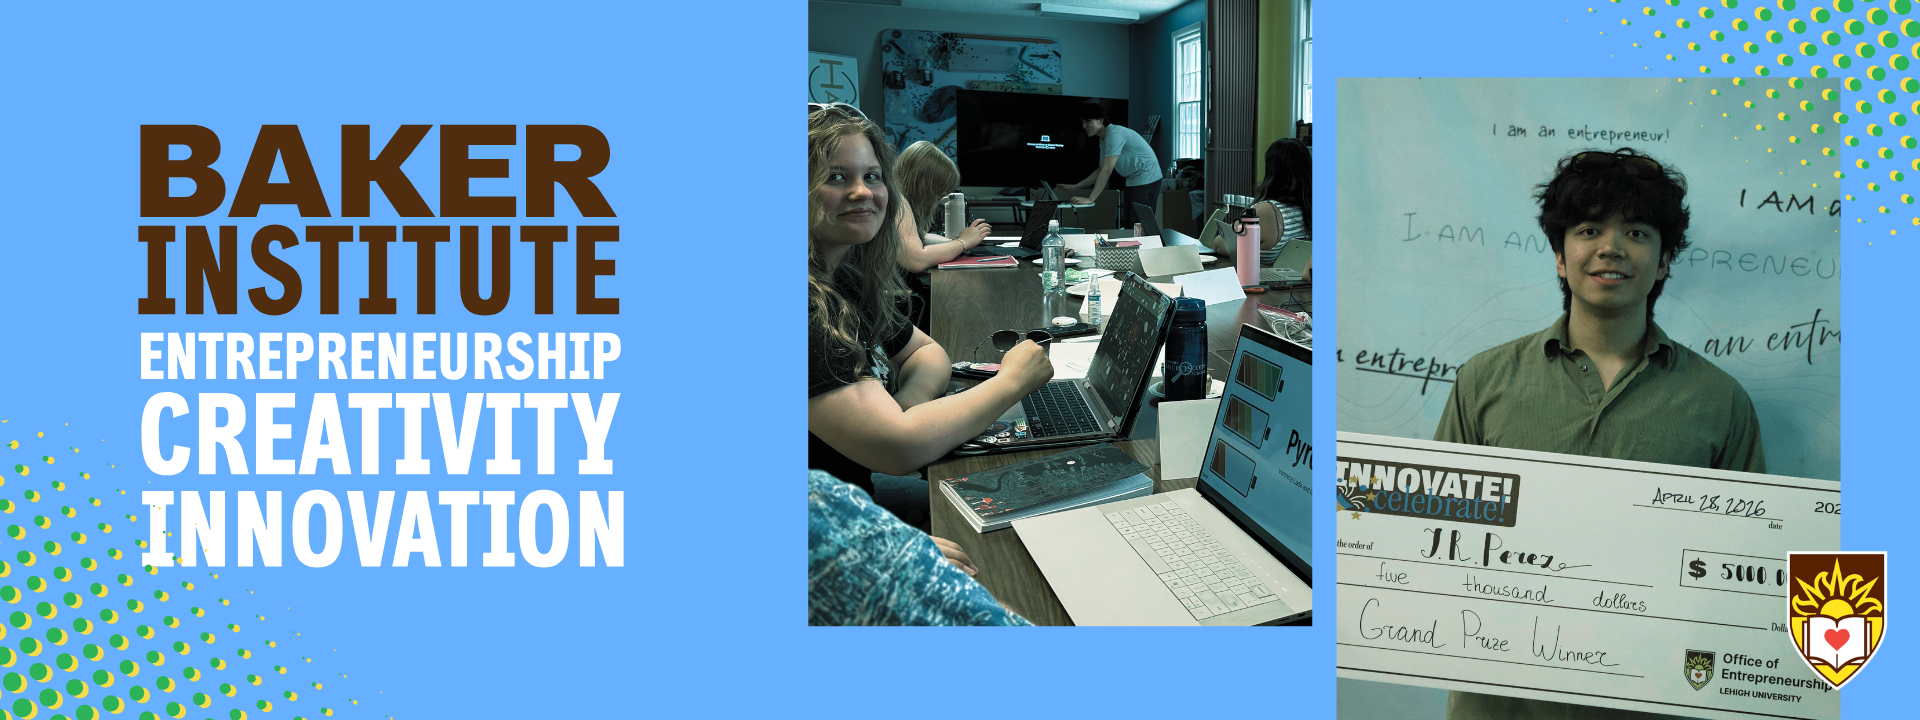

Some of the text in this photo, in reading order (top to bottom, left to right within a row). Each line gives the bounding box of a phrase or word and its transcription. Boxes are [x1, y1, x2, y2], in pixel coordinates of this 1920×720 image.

[1492, 123, 1670, 145] I am an entrepreneur!
[1739, 188, 1746, 208] I
[1757, 190, 1815, 215] AM
[1402, 212, 1841, 280] I AM AN PRENEU
[1704, 308, 1841, 366] an entr
[1337, 461, 1514, 504] INNOVATE!
[1373, 485, 1507, 523] celebrate!
[1699, 494, 1721, 513] 28,
[1725, 498, 1766, 518] 2026
[1768, 521, 1783, 531] date
[1337, 539, 1375, 551] the order of
[1375, 561, 1647, 613] five thousand dollars
[1720, 563, 1787, 587] 5000.0
[1359, 598, 1620, 668] Grand Prize Winner
[1723, 653, 1780, 670] Office of
[1721, 668, 1833, 693] Entrepreneurship
[1719, 687, 1802, 703] LEHIGH UNIVERSITY
